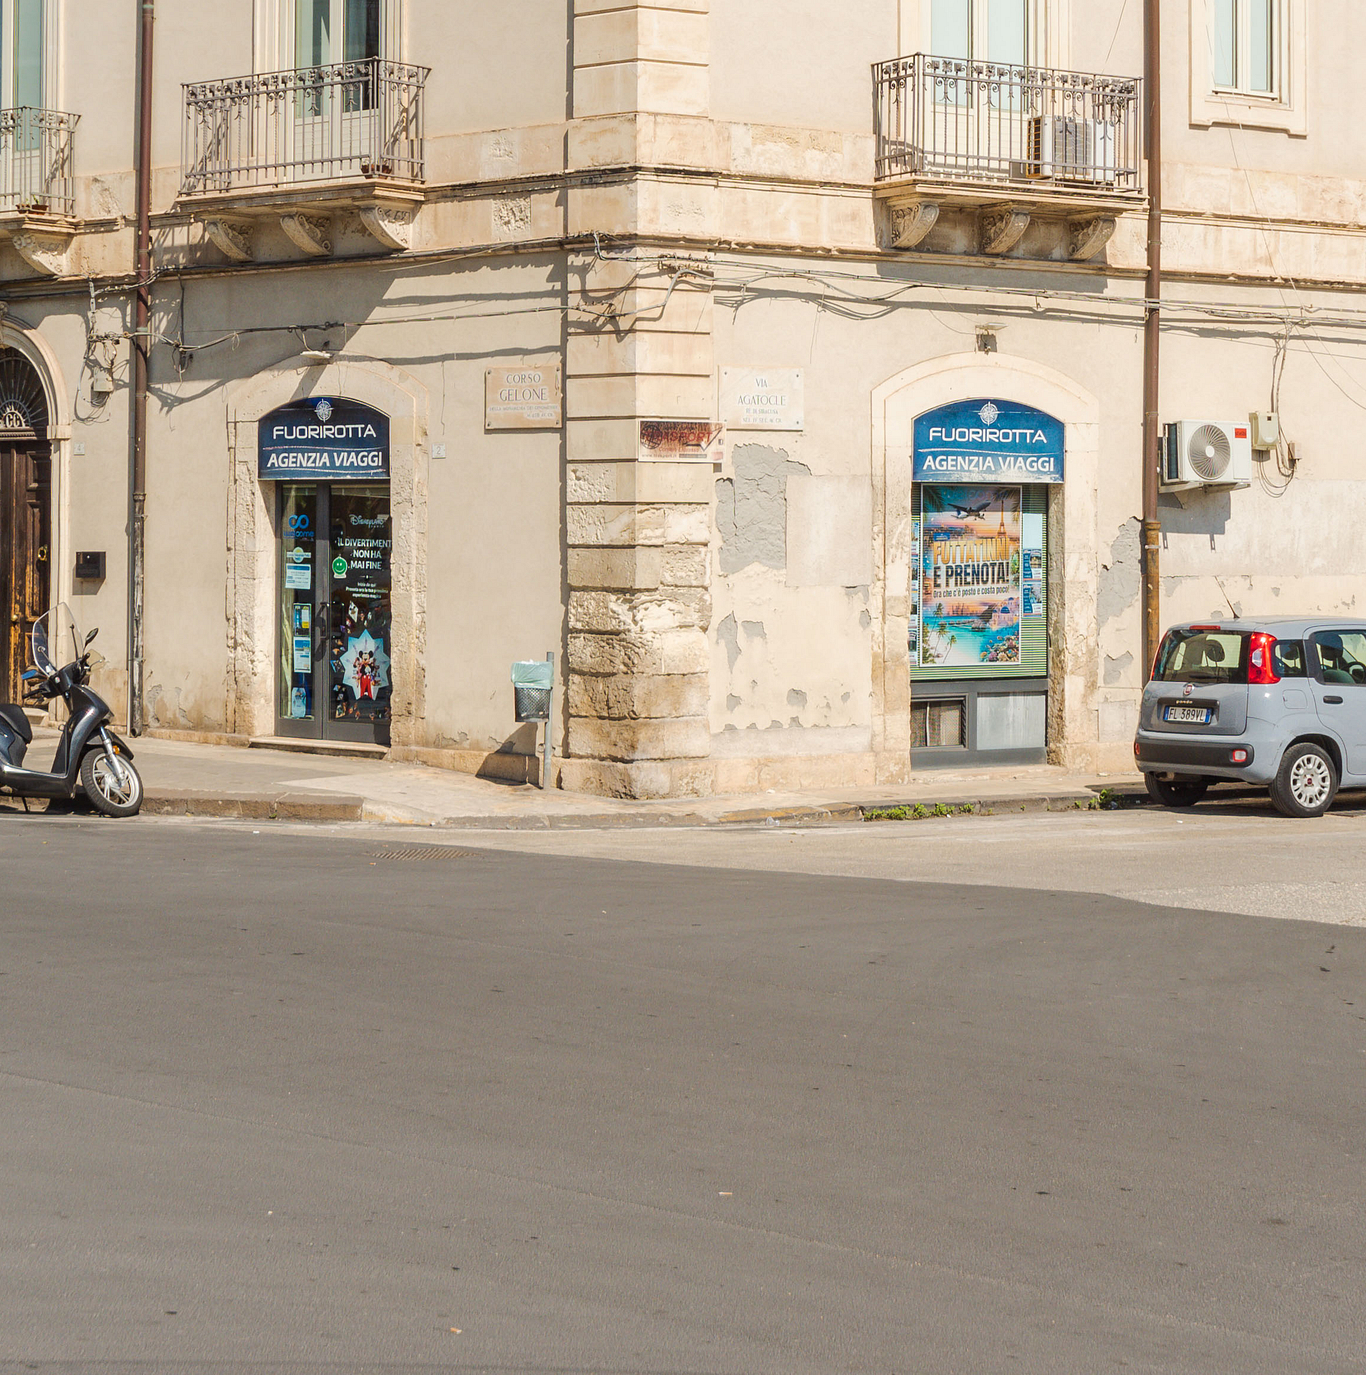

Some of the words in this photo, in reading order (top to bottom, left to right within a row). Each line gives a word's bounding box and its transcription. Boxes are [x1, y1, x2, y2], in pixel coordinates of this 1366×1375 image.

[506, 373, 541, 384] CORSO
[755, 378, 768, 388] VIA
[499, 388, 548, 402] GELONE
[738, 395, 786, 406] AGATOCLE
[272, 424, 377, 440] FUORIROTTA
[929, 427, 1048, 444] FUORIROTTA
[436, 445, 442, 455] 2
[266, 452, 331, 468] AGENZIA
[333, 451, 383, 467] VIAGGI
[922, 455, 995, 471] AGENZIA
[997, 456, 1055, 472] VIAGGI
[337, 537, 345, 547] IL
[344, 538, 392, 548] DIVERTIMENT
[353, 549, 370, 559] NON
[371, 550, 383, 559] HA
[933, 537, 1010, 565] FUTTATINNI
[350, 560, 365, 570] MAI
[365, 561, 382, 570] FINE
[933, 565, 941, 588] E
[945, 561, 1010, 588] PRENOTA!
[942, 589, 952, 598] che
[961, 587, 976, 597] posto
[981, 586, 996, 595] costa
[1168, 708, 1178, 720] FL
[1180, 708, 1204, 722] 389VL
